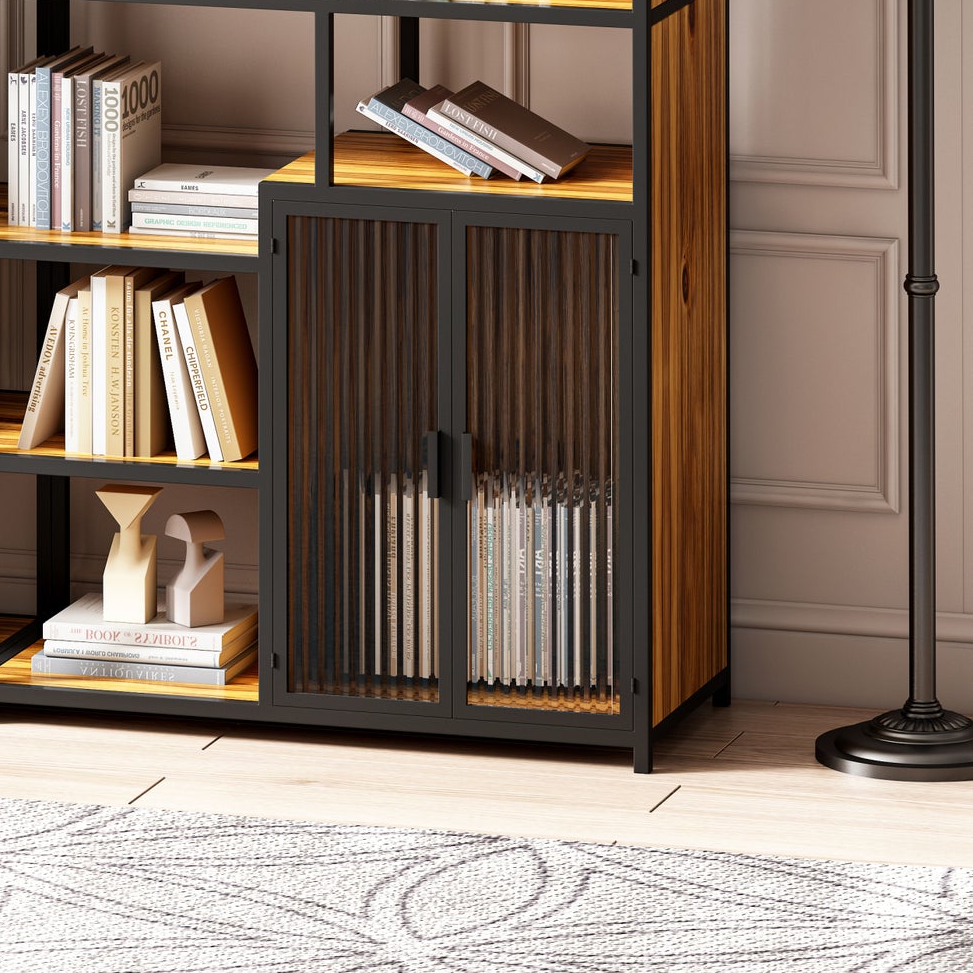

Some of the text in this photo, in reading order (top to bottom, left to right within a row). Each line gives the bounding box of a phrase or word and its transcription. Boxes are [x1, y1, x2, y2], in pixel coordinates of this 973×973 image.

[77, 80, 87, 147] LOST FISH
[104, 87, 119, 132] 1000
[122, 70, 159, 119] 1000
[37, 73, 49, 221] ALEXEY BRODOVITCH
[94, 127, 101, 137] IT
[371, 103, 485, 173] ALEXEY BRODOVITCH
[438, 127, 462, 144] Gardens
[469, 145, 489, 160] France
[445, 104, 498, 140] LOST FISH
[176, 219, 201, 227] DESIGN
[111, 307, 119, 359] KONSTEN
[159, 311, 174, 361] CHANEL
[28, 325, 58, 413] AVEDON advertising
[186, 346, 208, 412] CHIPPERFIELD
